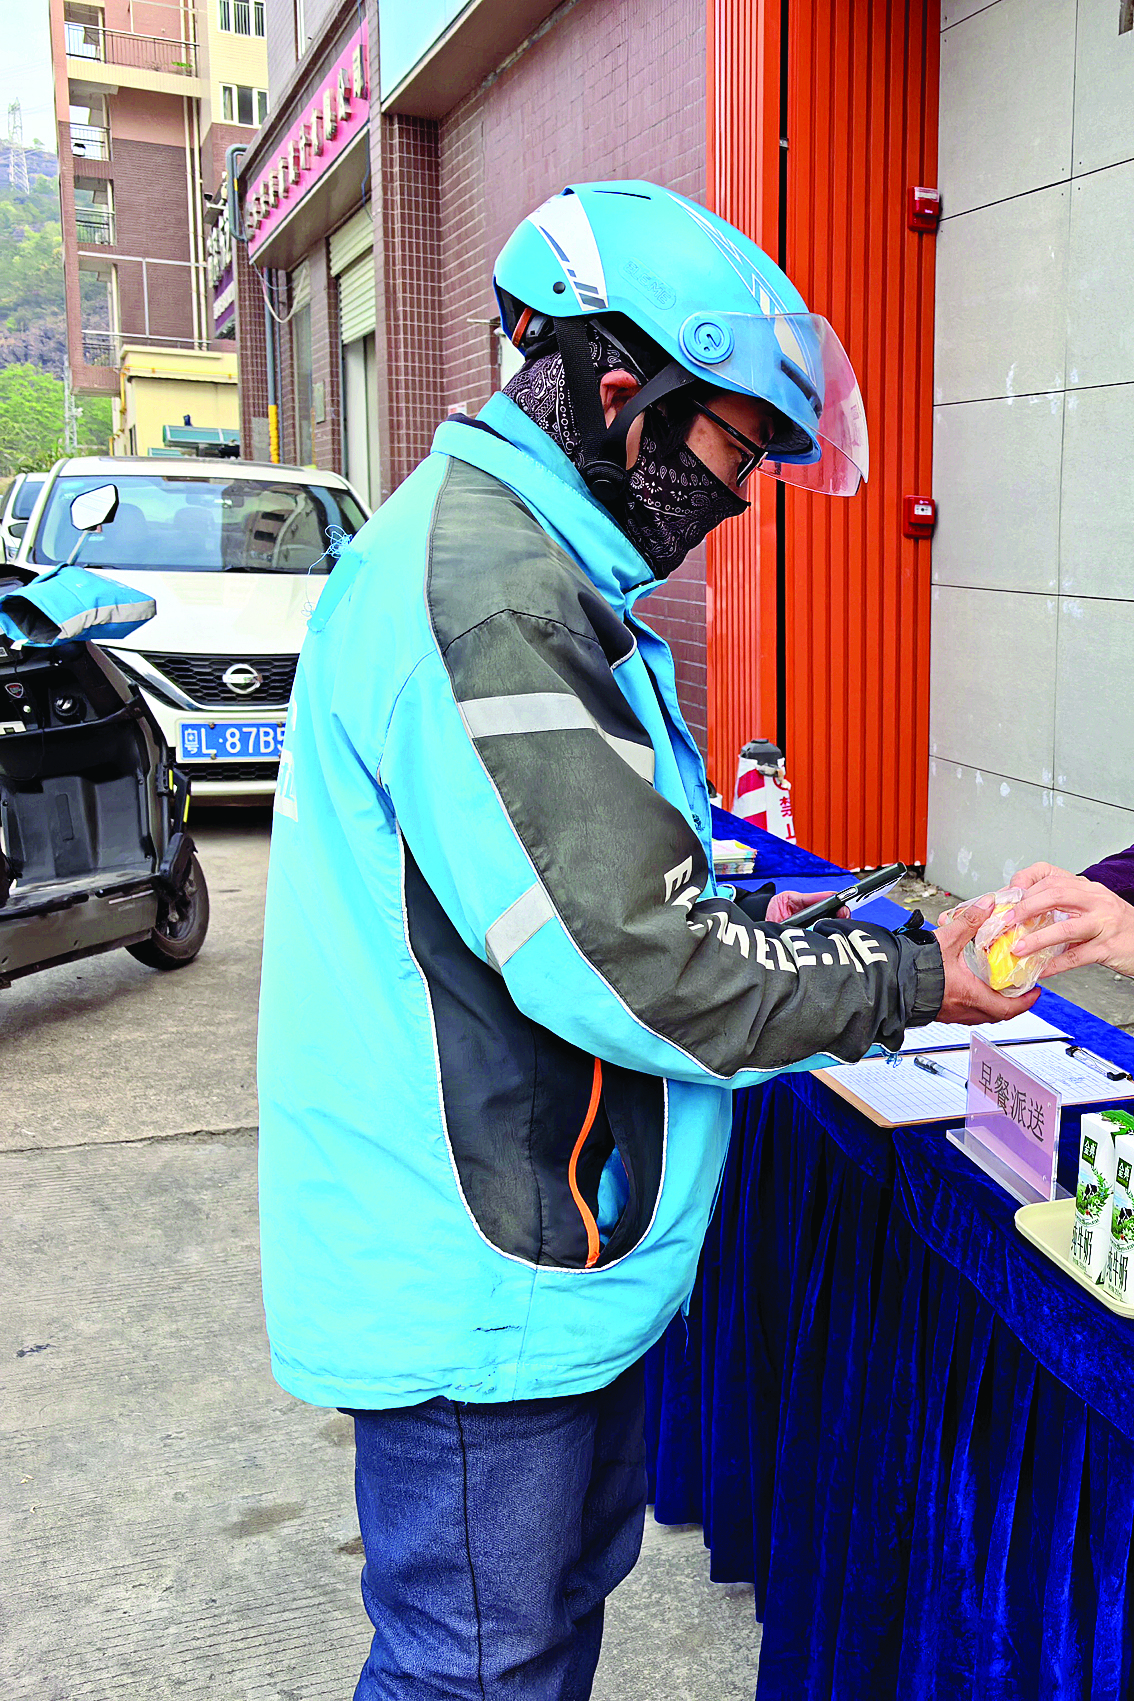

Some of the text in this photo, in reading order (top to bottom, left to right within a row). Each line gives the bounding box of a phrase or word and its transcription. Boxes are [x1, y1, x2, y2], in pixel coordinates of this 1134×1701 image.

[978, 1061, 1046, 1143] 早餐派送
[1117, 1161, 1132, 1182] 金典
